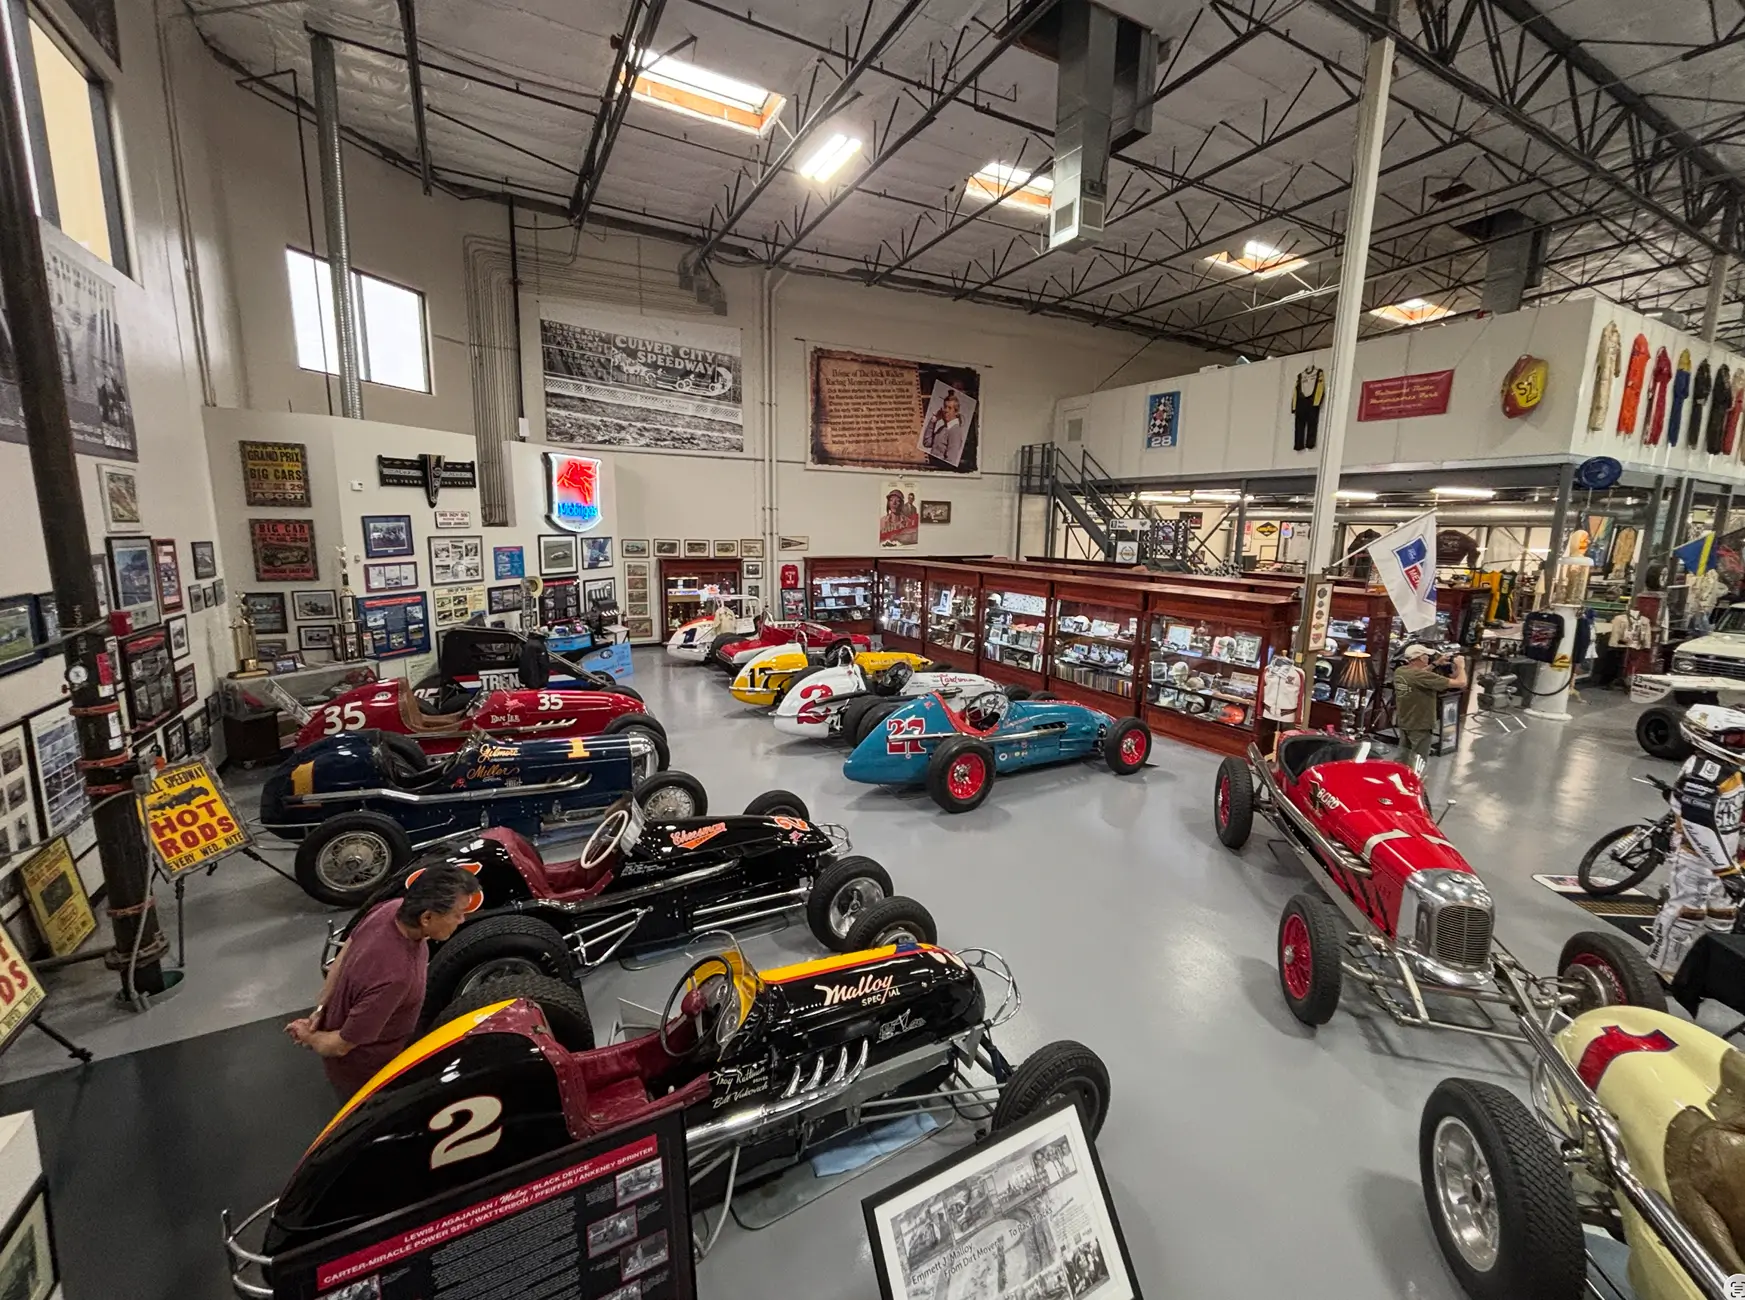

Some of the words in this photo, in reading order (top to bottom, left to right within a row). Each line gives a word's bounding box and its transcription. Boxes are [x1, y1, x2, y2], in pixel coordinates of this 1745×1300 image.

[614, 336, 673, 356] CULVER
[678, 347, 717, 362] CITY
[636, 352, 717, 374] SPEEDWAY
[870, 368, 884, 378] Dick
[826, 377, 846, 387] Racing
[848, 378, 883, 386] Memorabilia
[1152, 436, 1172, 448] 28
[248, 450, 278, 462] GRAND
[280, 451, 300, 462] PRIX
[250, 468, 269, 480] BIG
[274, 469, 302, 480] CARS
[253, 492, 304, 500] ASCOT
[290, 484, 304, 492] 29
[558, 502, 598, 520] Mobilgas
[259, 524, 278, 534] BIG
[285, 524, 306, 534] CAR
[480, 673, 526, 691] TREN
[747, 666, 774, 696] 17
[537, 694, 564, 710] 35
[796, 684, 834, 724] 2
[324, 701, 366, 735] 35
[887, 718, 926, 754] 27
[478, 744, 521, 763] Gilmore
[568, 737, 590, 759] 1
[164, 766, 206, 788] SPEEDWAY
[467, 762, 520, 780] Miller
[150, 798, 218, 840] HOT
[159, 816, 235, 858] RODS
[169, 854, 196, 872] EVERY
[200, 844, 222, 858] WED.
[224, 833, 244, 846] NITE
[815, 974, 894, 1006] Malloy
[861, 988, 900, 1007] SPECIAL
[714, 1070, 733, 1094] Troy
[712, 1092, 733, 1110] Bill
[733, 1082, 768, 1102] Vukovich
[428, 1096, 502, 1170] 2
[324, 1244, 412, 1284] CARTER-MIRACLE
[414, 1229, 448, 1248] POWER
[450, 1222, 469, 1234] SPL
[475, 1197, 529, 1224] WATTERSON
[534, 1178, 574, 1199] PFEIFFER
[579, 1162, 616, 1180] ANKENEY
[618, 1146, 653, 1164] SPRINTER
[404, 1226, 434, 1243] LEWIS
[441, 1202, 494, 1228] AGAJANIAN
[1008, 1228, 1018, 1238] To
[1018, 1220, 1032, 1236] Race
[1032, 1208, 1053, 1224] Tracks
[912, 1262, 942, 1286] Emmett
[949, 1242, 974, 1264] Malloy
[944, 1263, 964, 1278] From
[962, 1252, 977, 1269] Dirt
